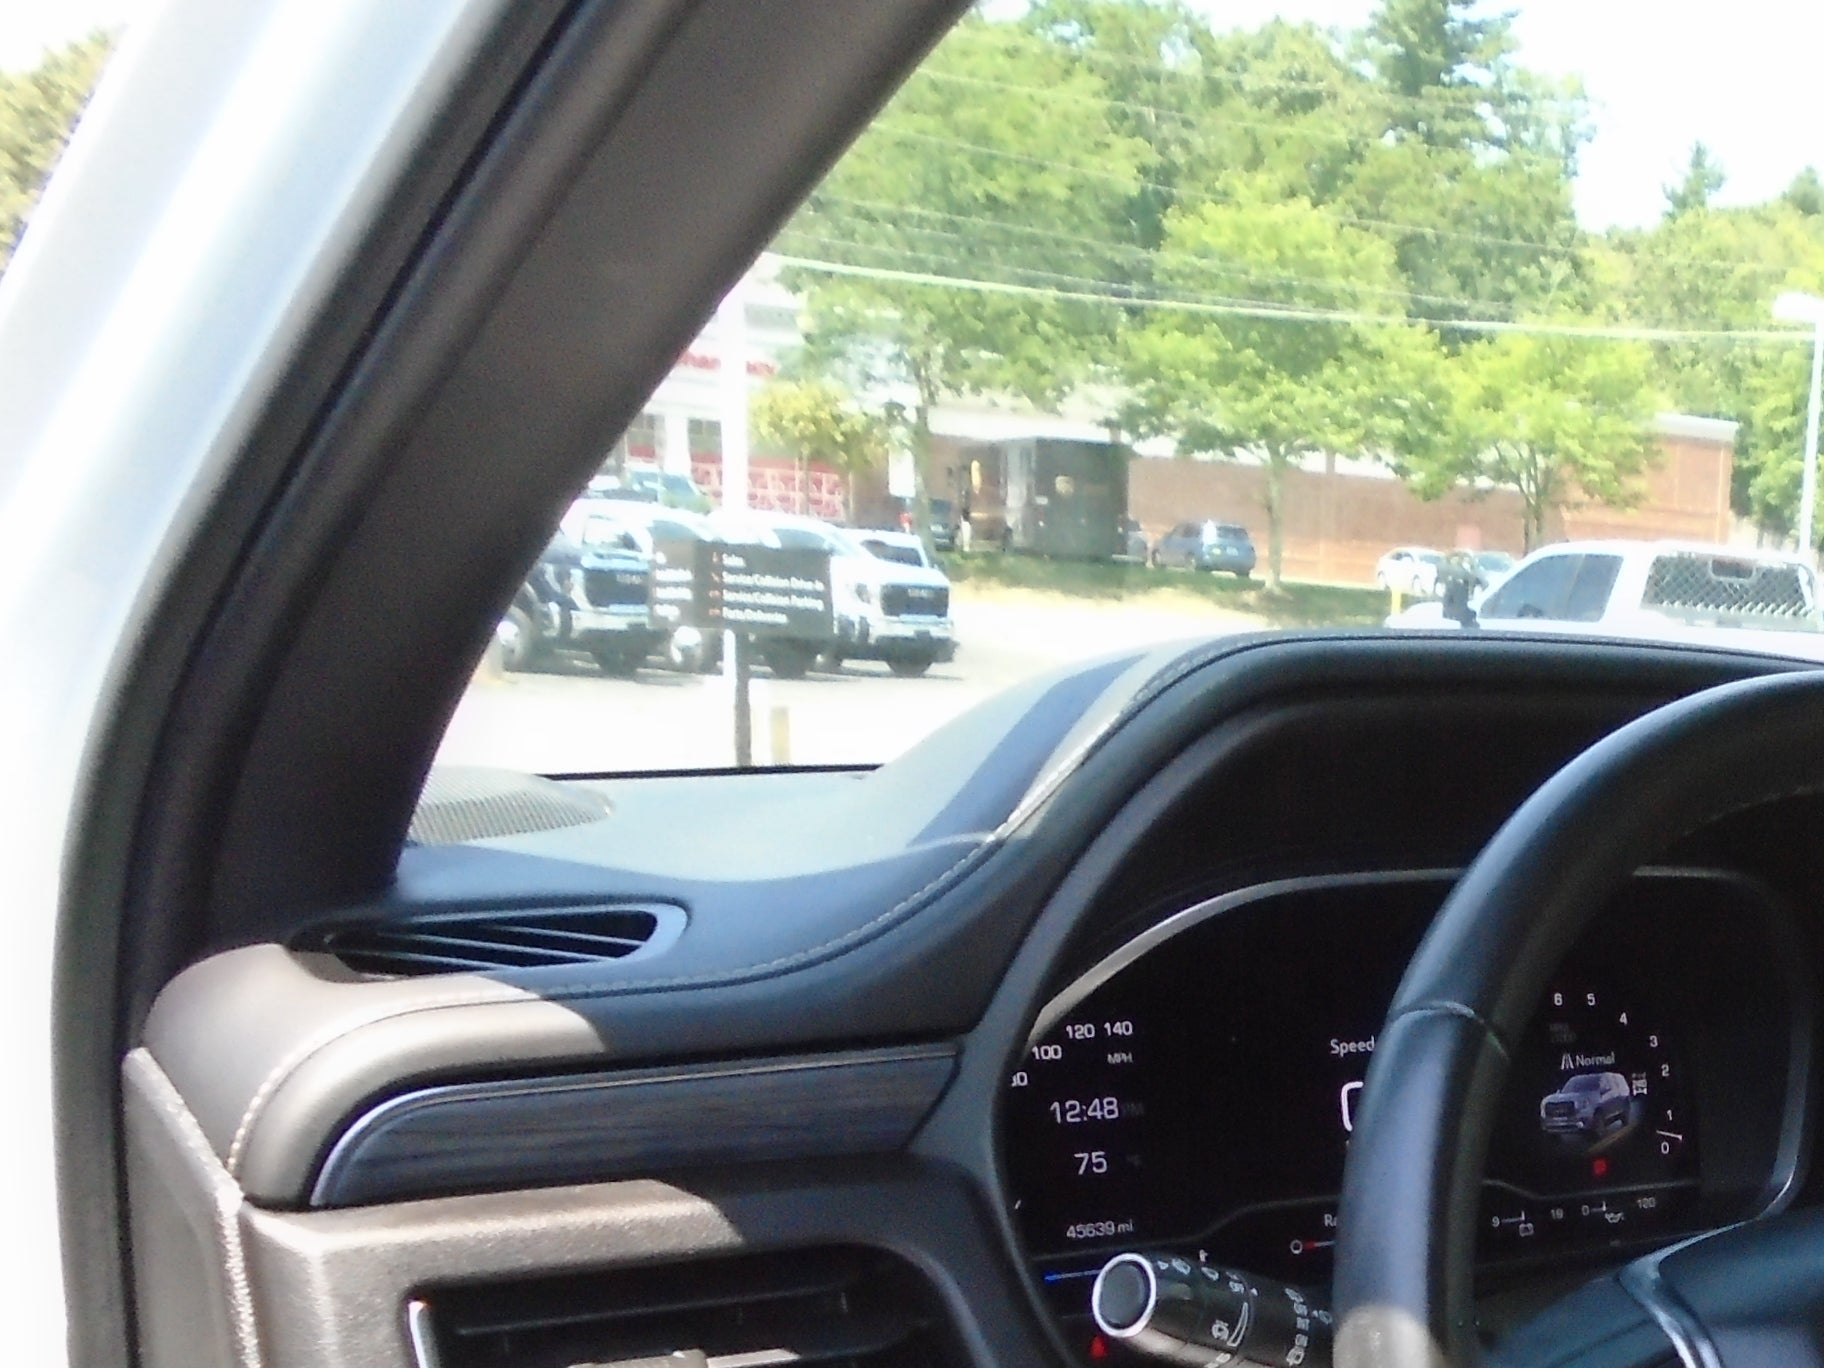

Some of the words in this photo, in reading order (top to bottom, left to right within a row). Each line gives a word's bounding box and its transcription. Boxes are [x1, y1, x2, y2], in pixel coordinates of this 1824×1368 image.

[1586, 992, 1597, 1007] 5
[1618, 1011, 1629, 1026] 4
[1066, 1023, 1096, 1040] 120
[1104, 1020, 1134, 1037] 140
[1330, 1035, 1376, 1058] Speed
[1649, 1034, 1659, 1049] 3
[1031, 1044, 1063, 1061] 100
[1107, 1052, 1134, 1065] MPH
[1575, 1051, 1617, 1068] Normal
[1660, 1062, 1671, 1078] 2
[1050, 1096, 1120, 1124] 12:48
[1660, 1140, 1671, 1155] 0
[1074, 1151, 1109, 1176] 75
[1066, 1220, 1116, 1240] 45639
[1117, 1218, 1134, 1234] mi
